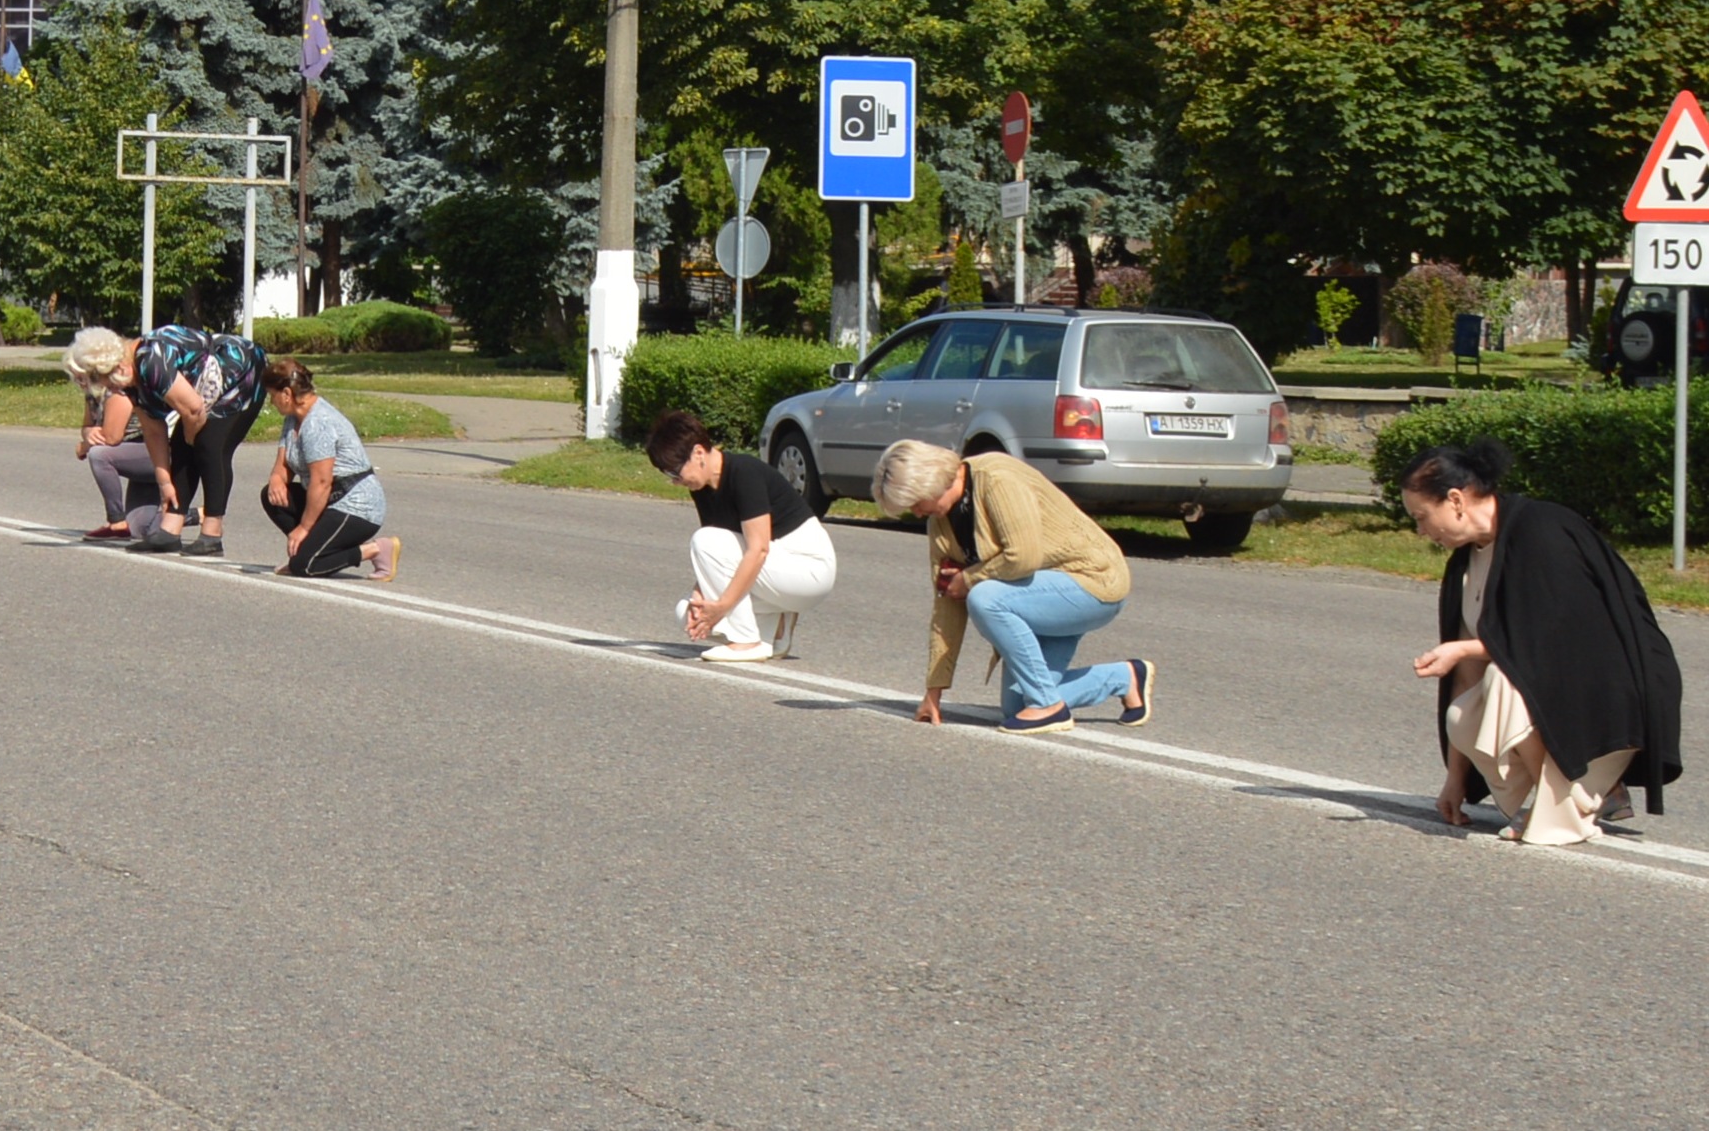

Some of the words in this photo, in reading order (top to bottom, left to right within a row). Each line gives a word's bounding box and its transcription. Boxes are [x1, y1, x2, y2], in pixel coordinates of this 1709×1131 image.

[1649, 239, 1702, 271] 150
[1160, 417, 1174, 430] AI
[1178, 418, 1204, 431] 1359
[1206, 419, 1225, 432] HX
